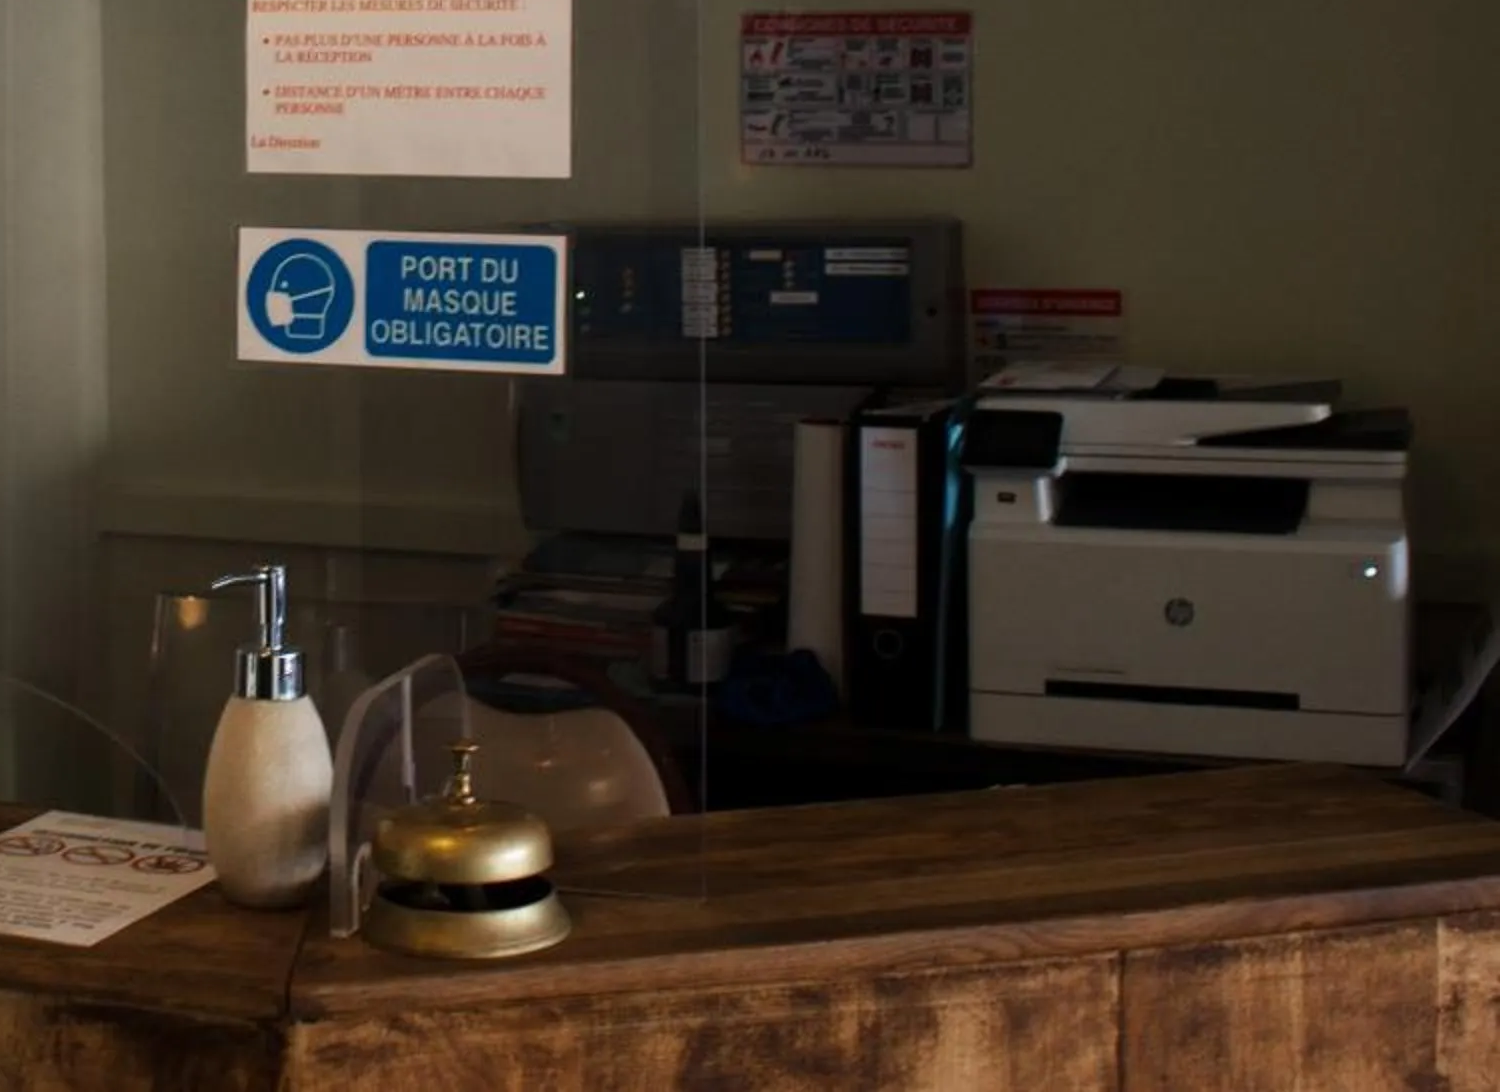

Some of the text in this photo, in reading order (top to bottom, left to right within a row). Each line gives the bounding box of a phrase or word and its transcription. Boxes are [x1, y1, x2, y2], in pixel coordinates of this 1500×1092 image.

[401, 255, 519, 284] PORT DU
[403, 287, 518, 317] MASQUE
[371, 319, 550, 351] OBLIGATOIRE
